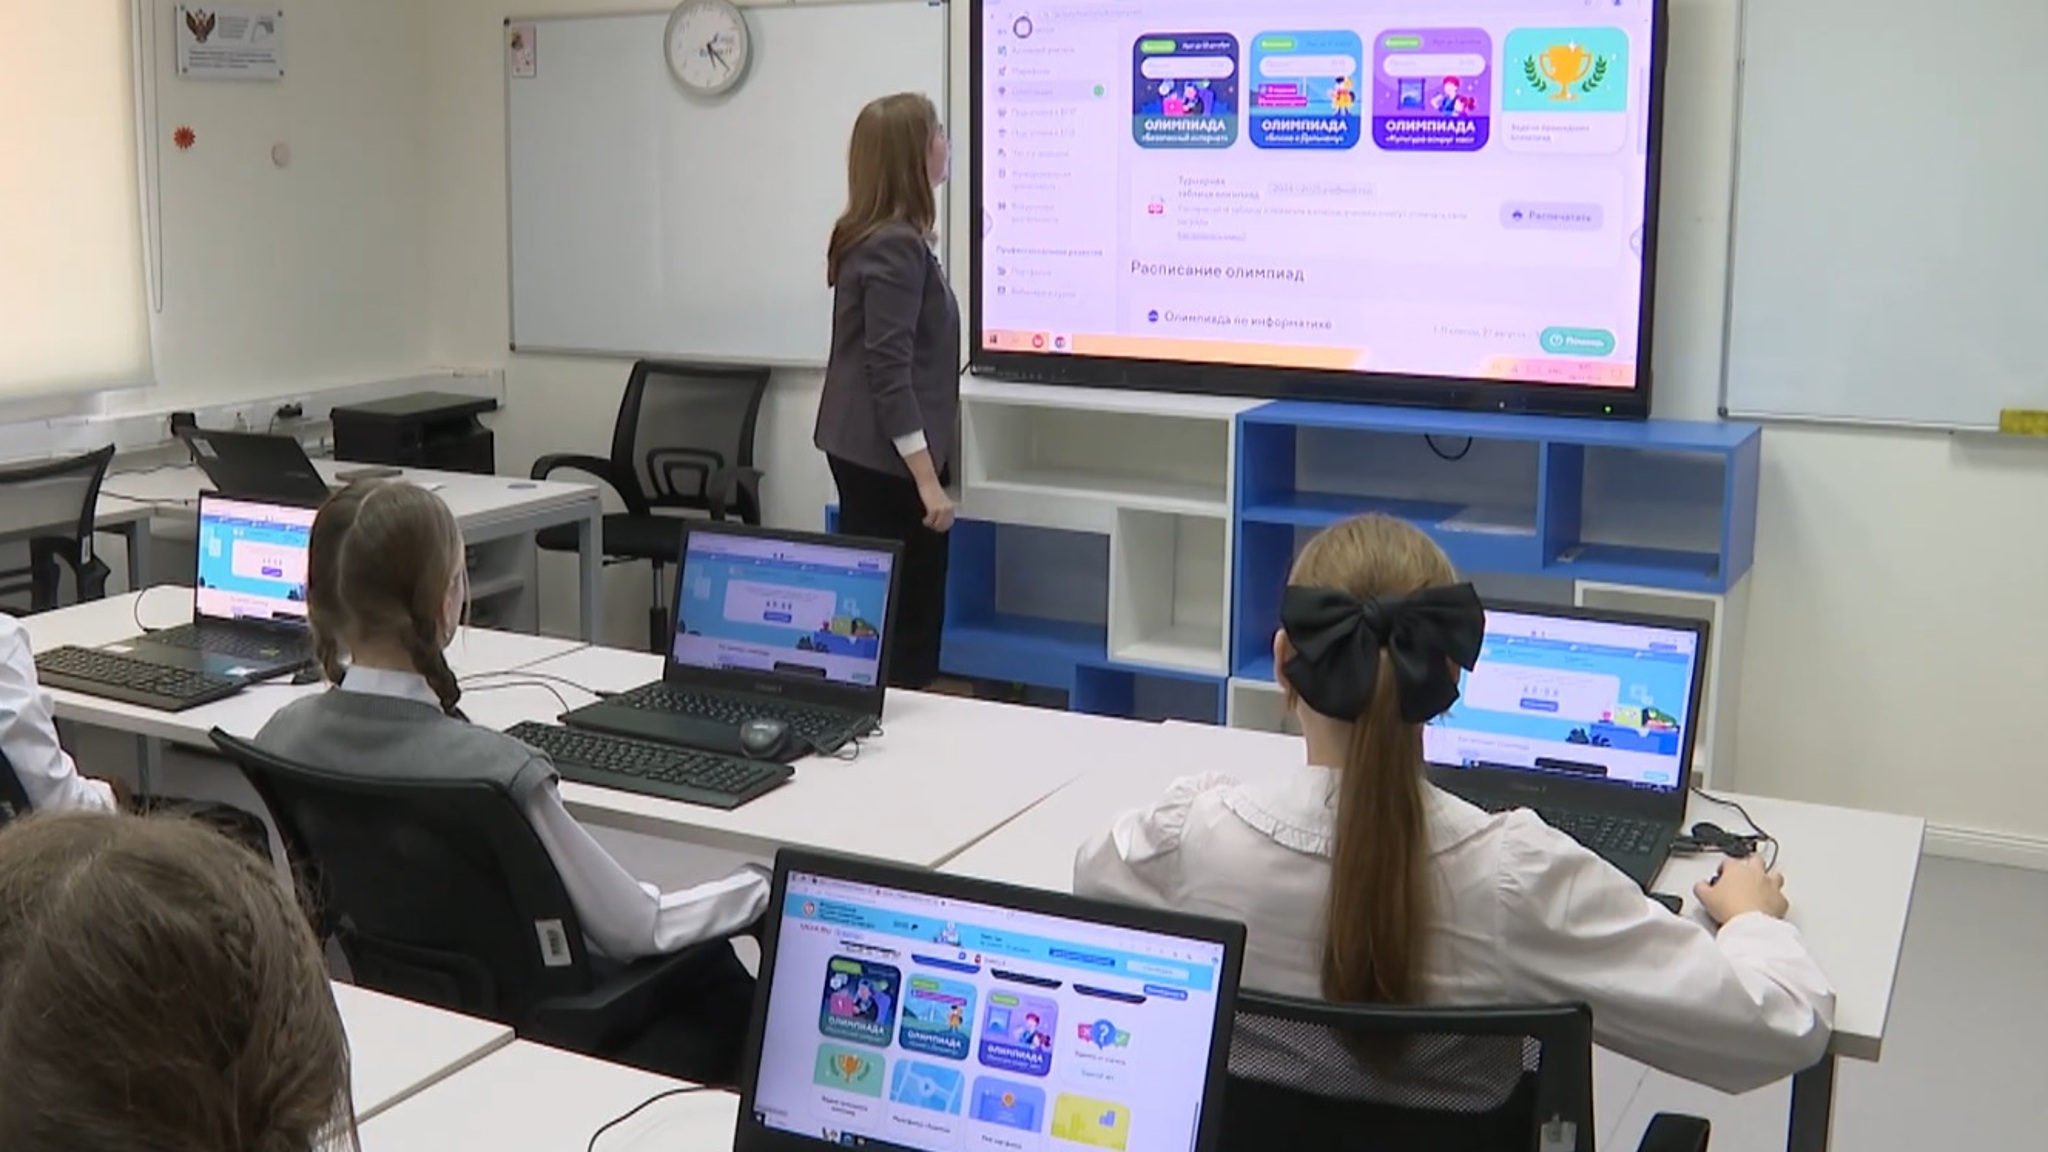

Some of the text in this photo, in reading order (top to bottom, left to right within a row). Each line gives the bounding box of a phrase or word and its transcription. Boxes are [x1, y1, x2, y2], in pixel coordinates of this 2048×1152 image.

[1144, 120, 1226, 132] ОЛИМПИАДА
[1261, 120, 1347, 132] ОЛИМПИАДА
[1385, 120, 1476, 133] ОЛИМПИАДА
[1130, 260, 1305, 282] Расписание олимпиад
[1164, 311, 1232, 325] Олимпиада
[1250, 317, 1332, 330] информатике
